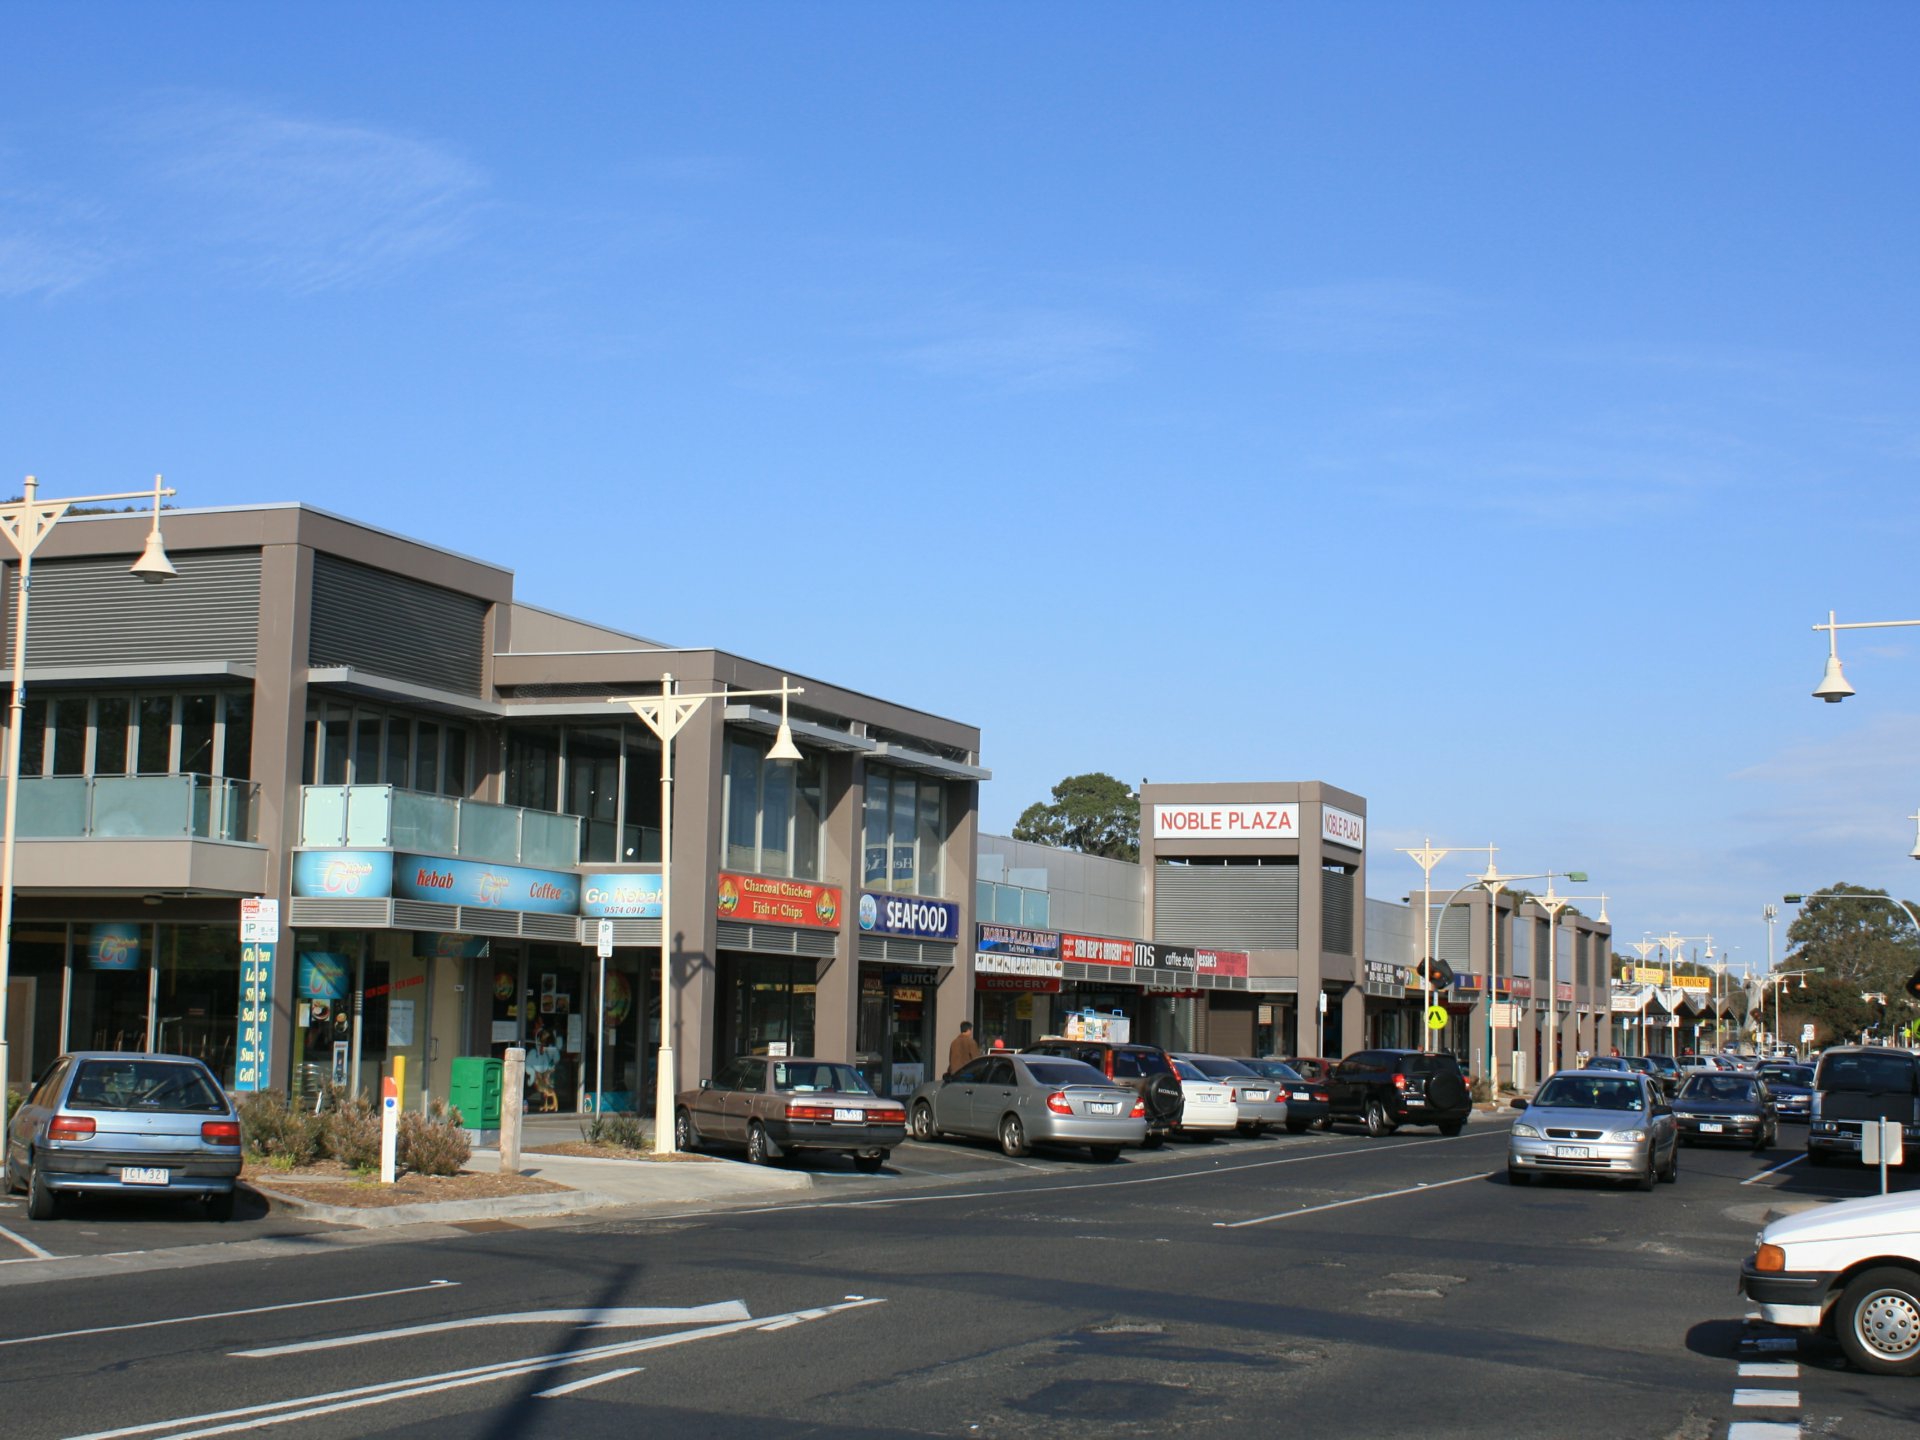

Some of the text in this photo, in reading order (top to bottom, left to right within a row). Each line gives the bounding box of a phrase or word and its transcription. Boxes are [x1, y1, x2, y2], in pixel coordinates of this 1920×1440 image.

[1161, 811, 1292, 830] NOBLE PLAZA
[1324, 811, 1361, 843] NOBLE PLAZA
[416, 868, 562, 901] Kebab Coffee
[743, 878, 813, 899] Charcoal Chicken
[585, 887, 610, 904] Go
[604, 905, 646, 915] 9574 0912
[752, 900, 804, 919] Fish n' Chips
[886, 900, 947, 933] SEAFOOD
[245, 923, 257, 934] 1P
[983, 926, 1009, 943] NOBLE
[1009, 928, 1032, 946] PLAZA
[1165, 951, 1182, 967] coffee
[1182, 953, 1195, 971] shop
[1196, 951, 1217, 972] Jessie's
[987, 979, 1049, 989] GROCERY
[1685, 978, 1707, 989] HOUSE
[1157, 1087, 1179, 1097] HONDA
[149, 1168, 167, 1180] 321
